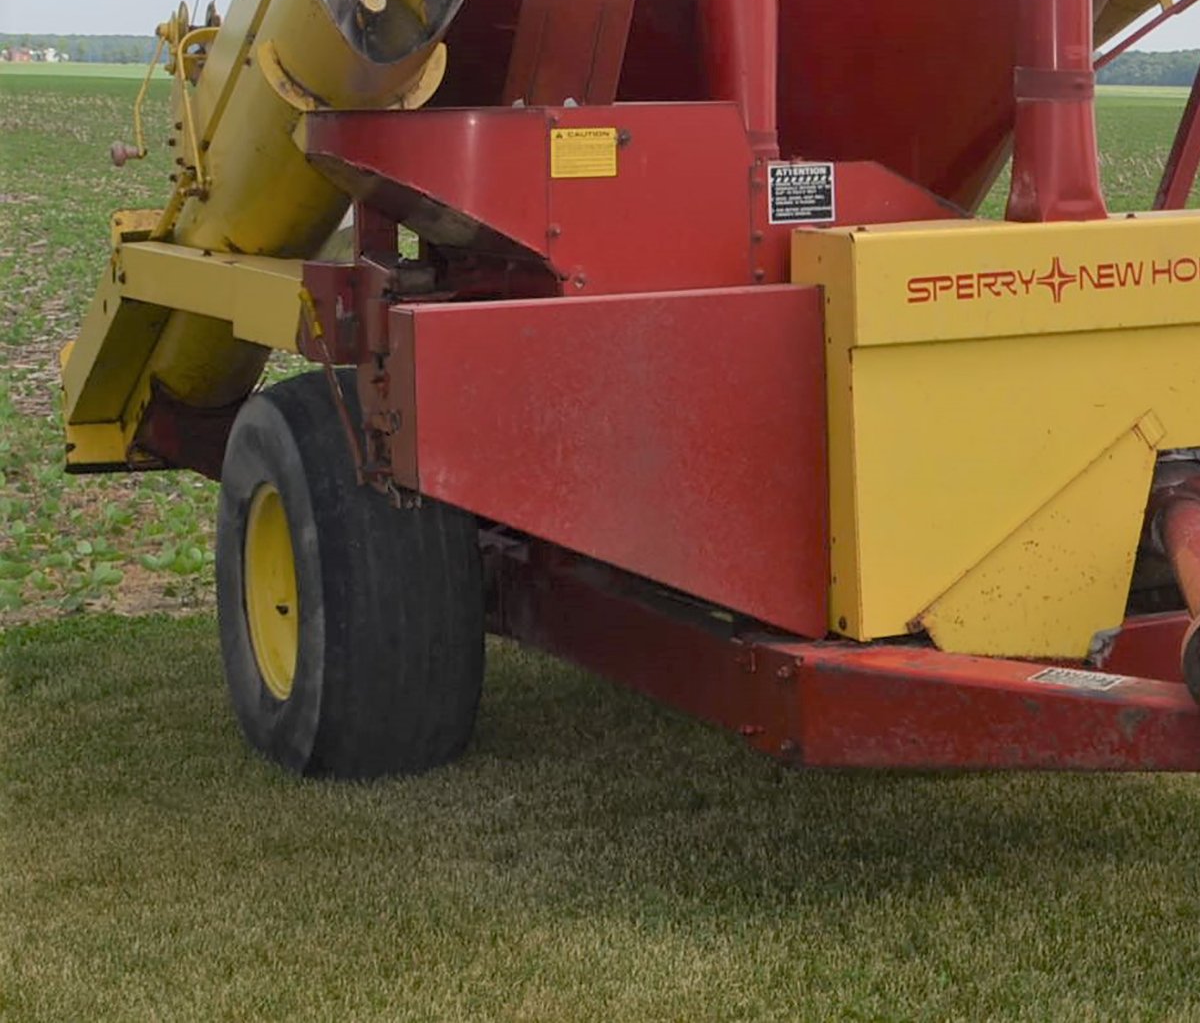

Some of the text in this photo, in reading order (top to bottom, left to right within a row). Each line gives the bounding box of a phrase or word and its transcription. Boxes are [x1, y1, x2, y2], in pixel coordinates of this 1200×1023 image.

[567, 130, 610, 138] CAUTION
[775, 167, 827, 177] ATTENTION
[906, 268, 1036, 304] SPERRY
[1079, 260, 1144, 291] NEW
